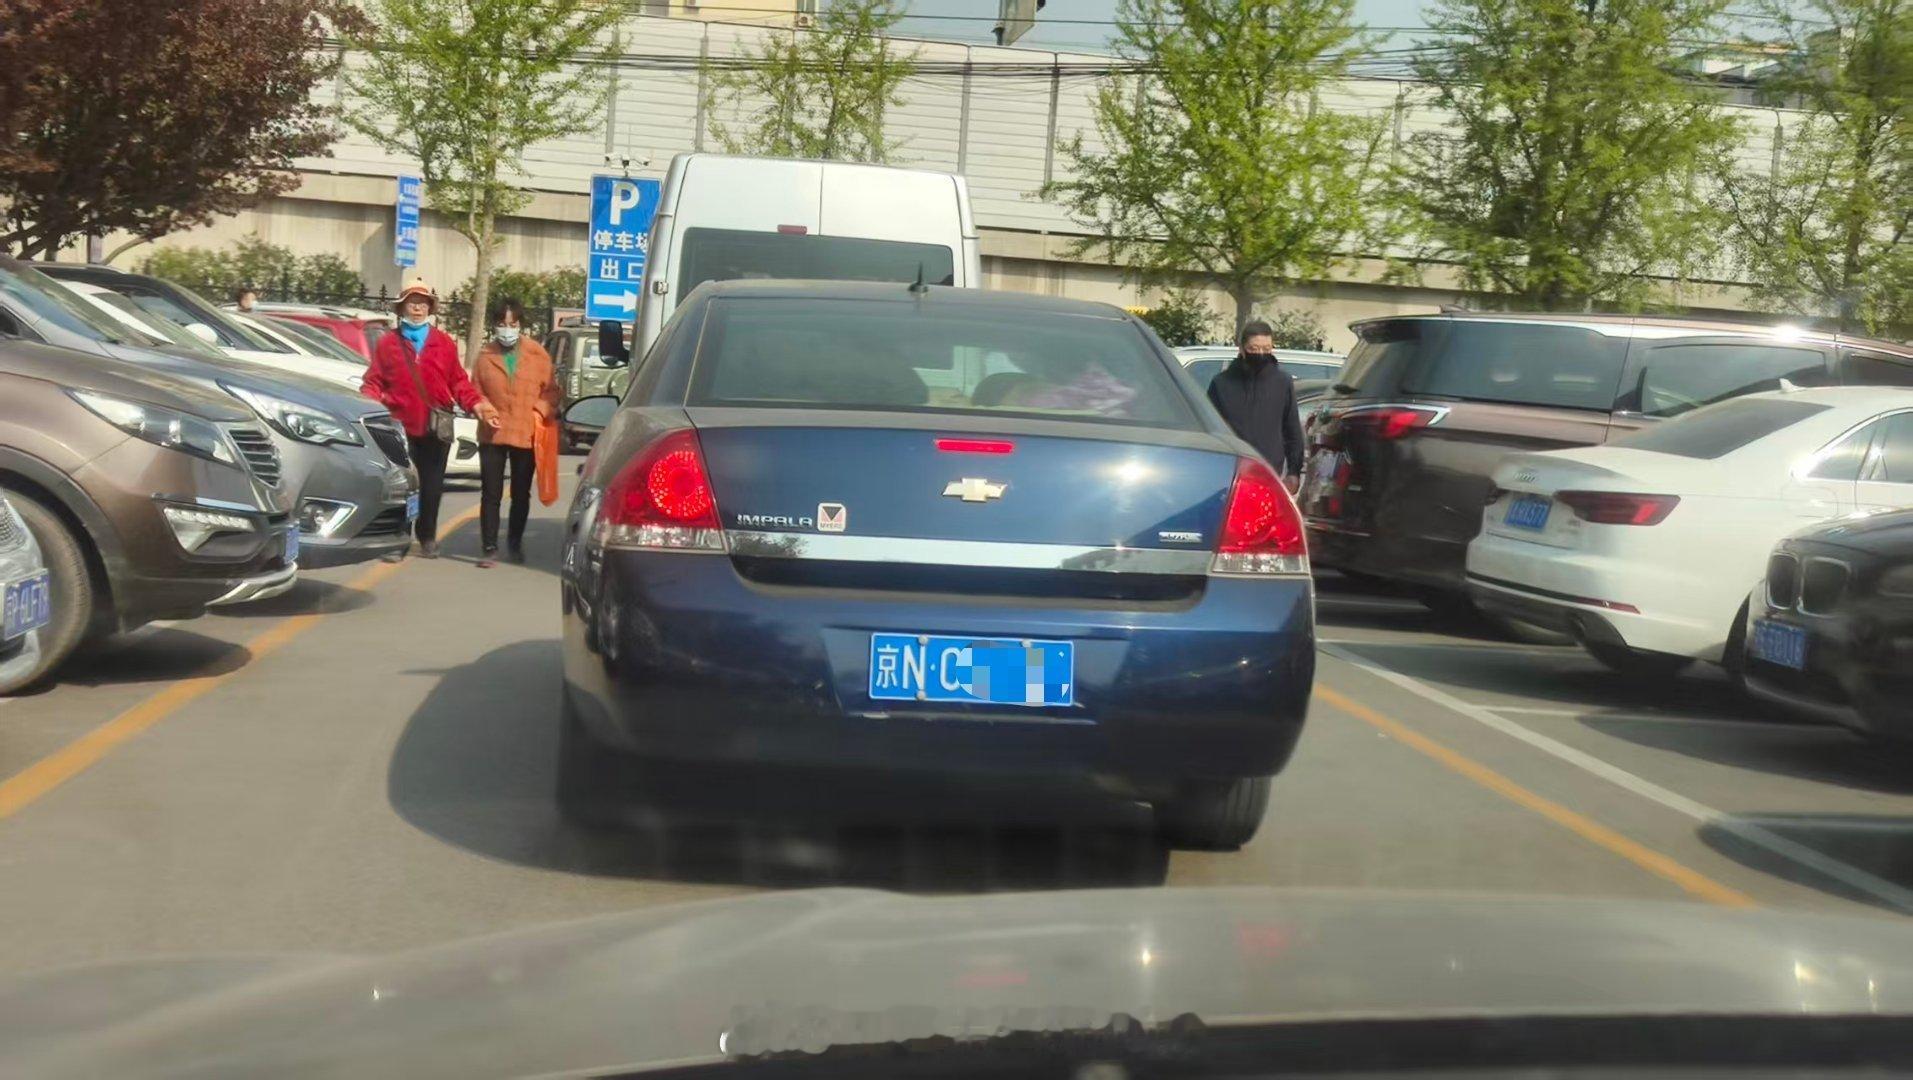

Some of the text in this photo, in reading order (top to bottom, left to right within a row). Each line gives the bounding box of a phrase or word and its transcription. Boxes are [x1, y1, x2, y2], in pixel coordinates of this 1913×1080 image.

[609, 180, 640, 226] P
[600, 258, 642, 280] 出口
[737, 513, 813, 527] IMPALA
